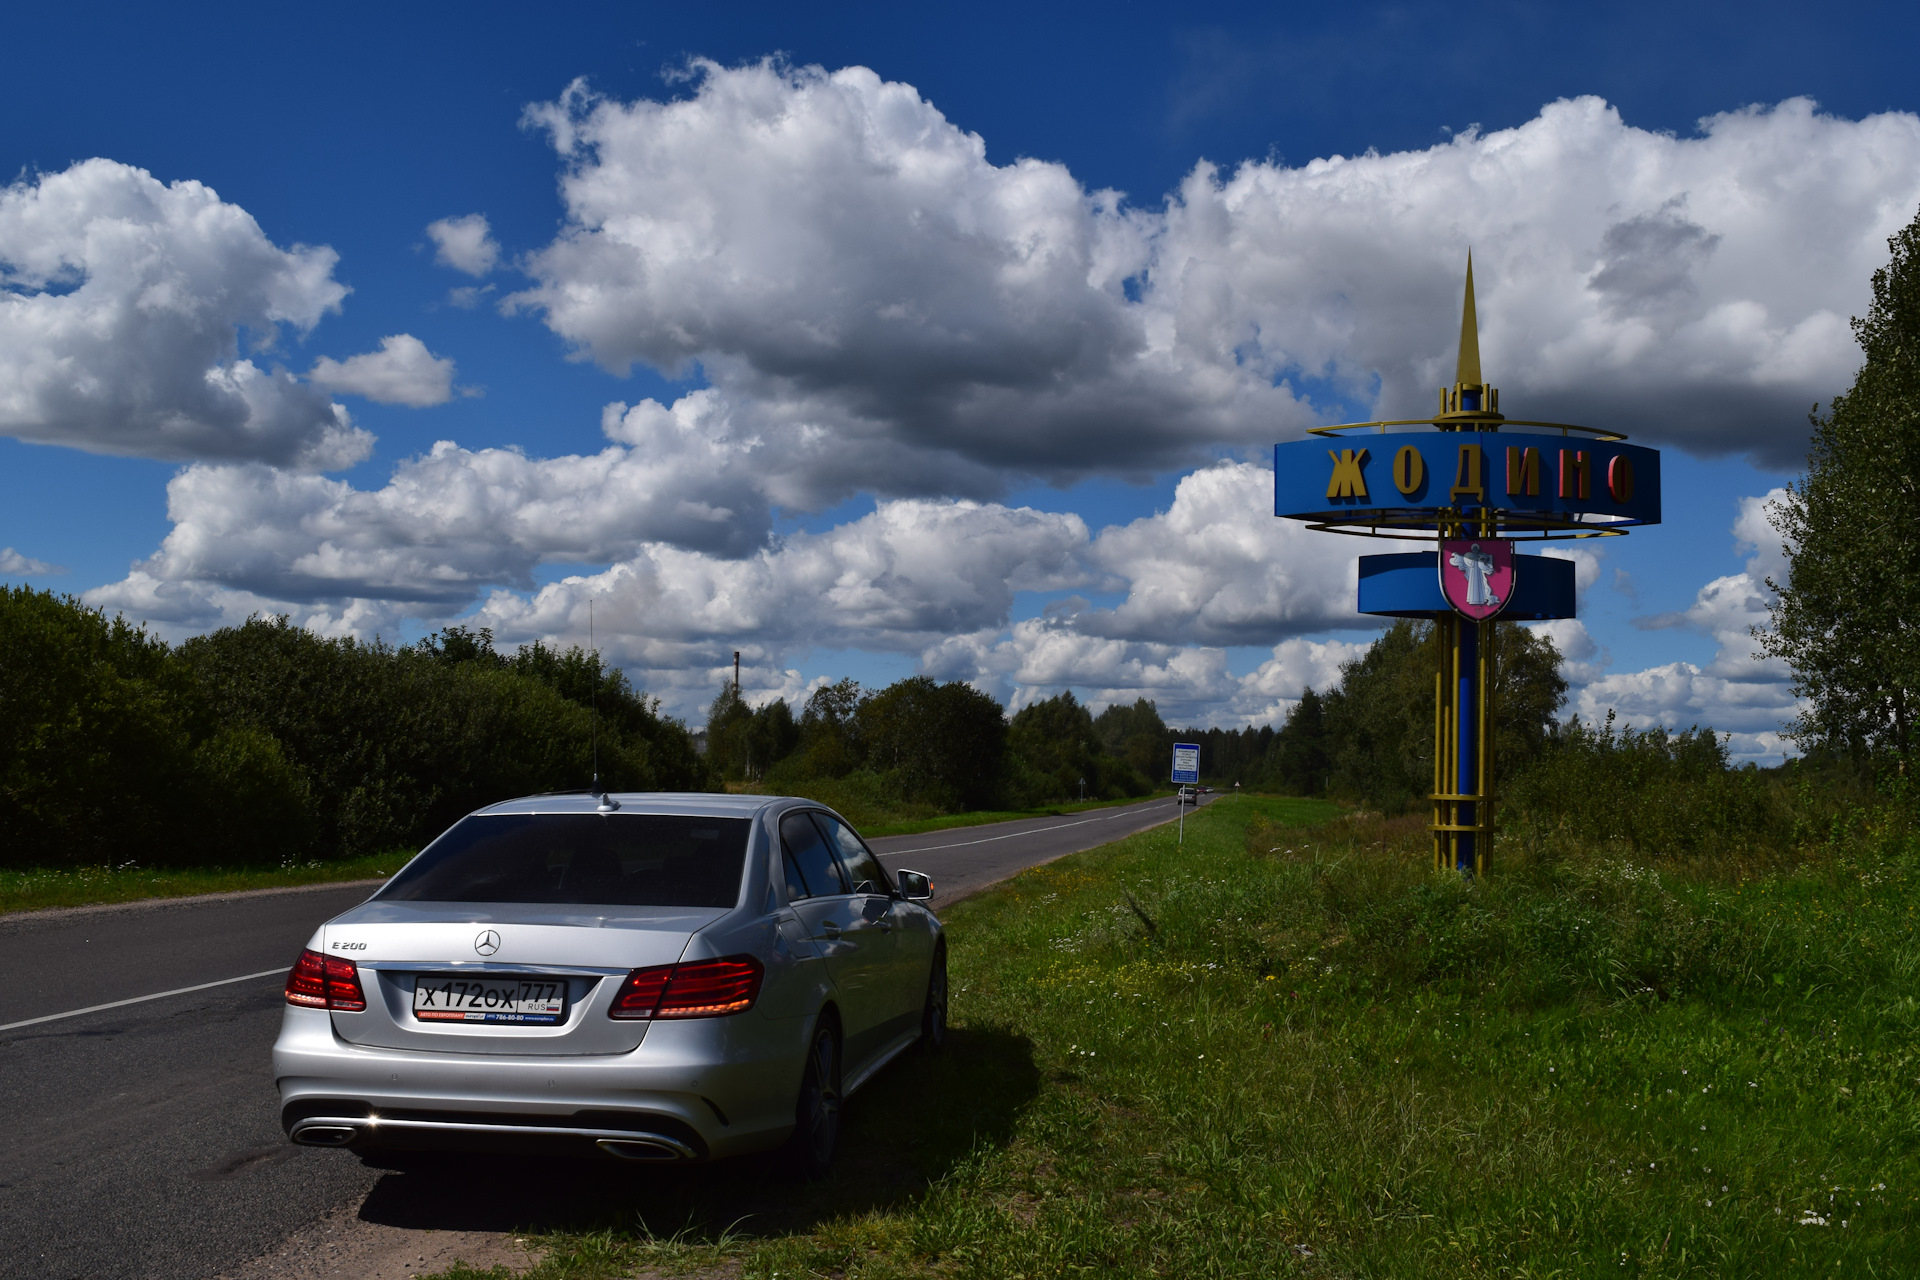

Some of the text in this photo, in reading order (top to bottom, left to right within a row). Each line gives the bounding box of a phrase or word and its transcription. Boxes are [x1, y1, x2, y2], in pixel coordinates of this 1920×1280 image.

[1326, 444, 1635, 503] ЖОДИНО
[341, 942, 367, 950] 200
[521, 982, 557, 1003] 777
[528, 1003, 546, 1011] RUS
